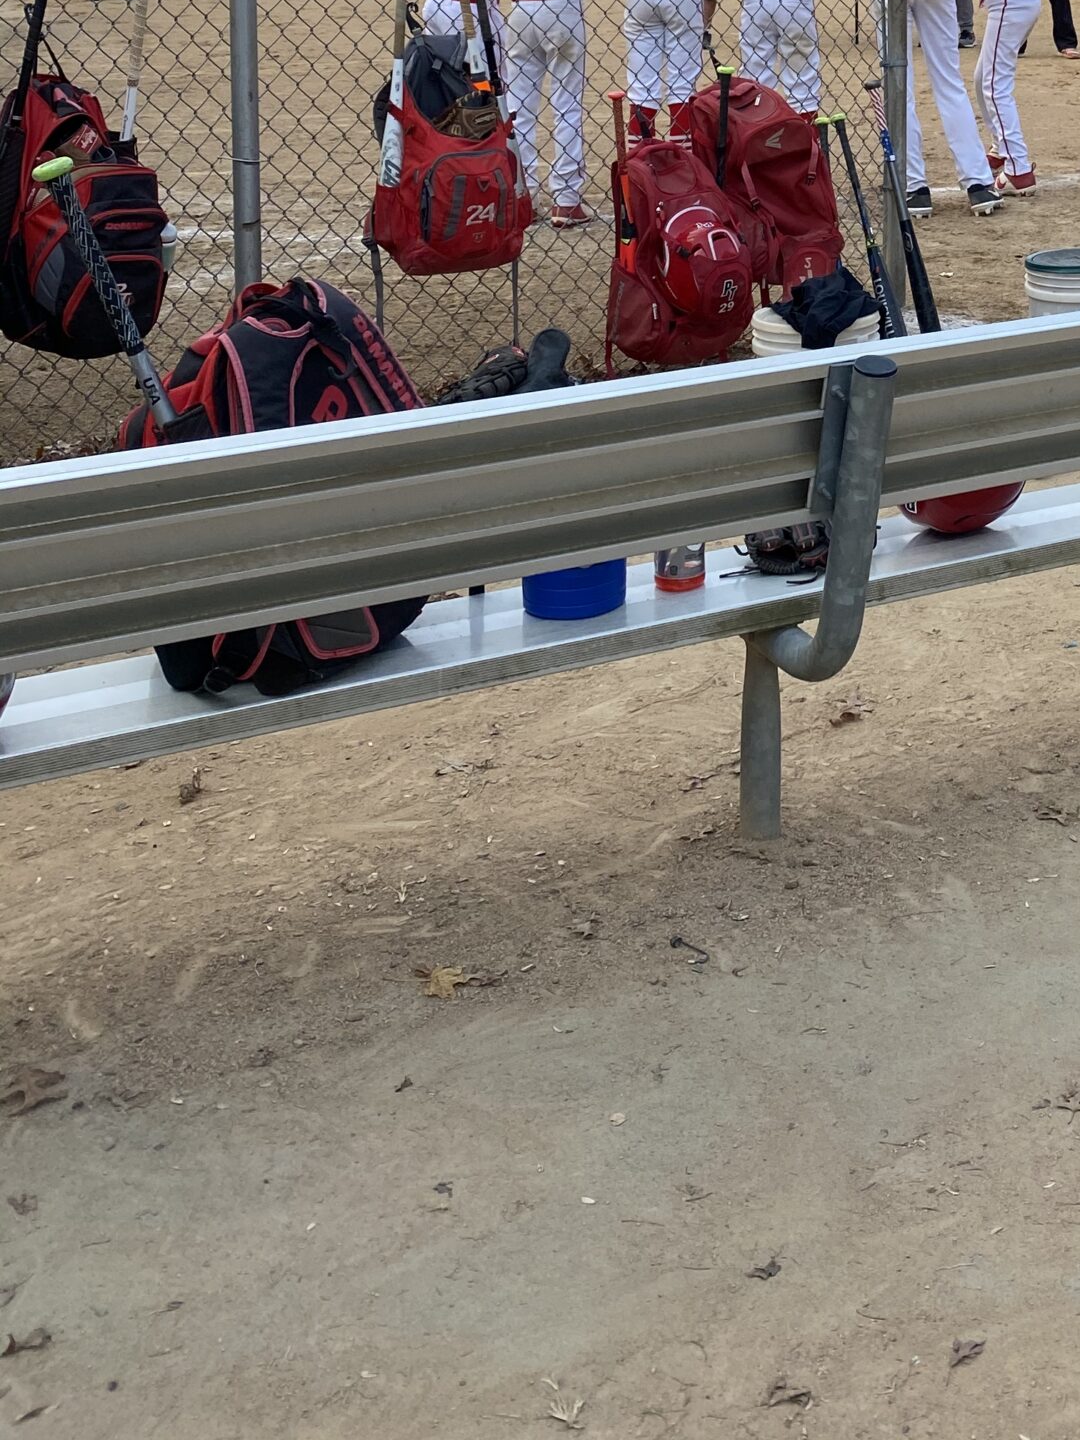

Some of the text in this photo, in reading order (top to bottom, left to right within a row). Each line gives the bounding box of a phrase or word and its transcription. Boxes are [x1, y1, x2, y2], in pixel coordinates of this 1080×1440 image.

[465, 202, 496, 226] 24
[720, 279, 738, 301] PT
[718, 301, 735, 314] 29
